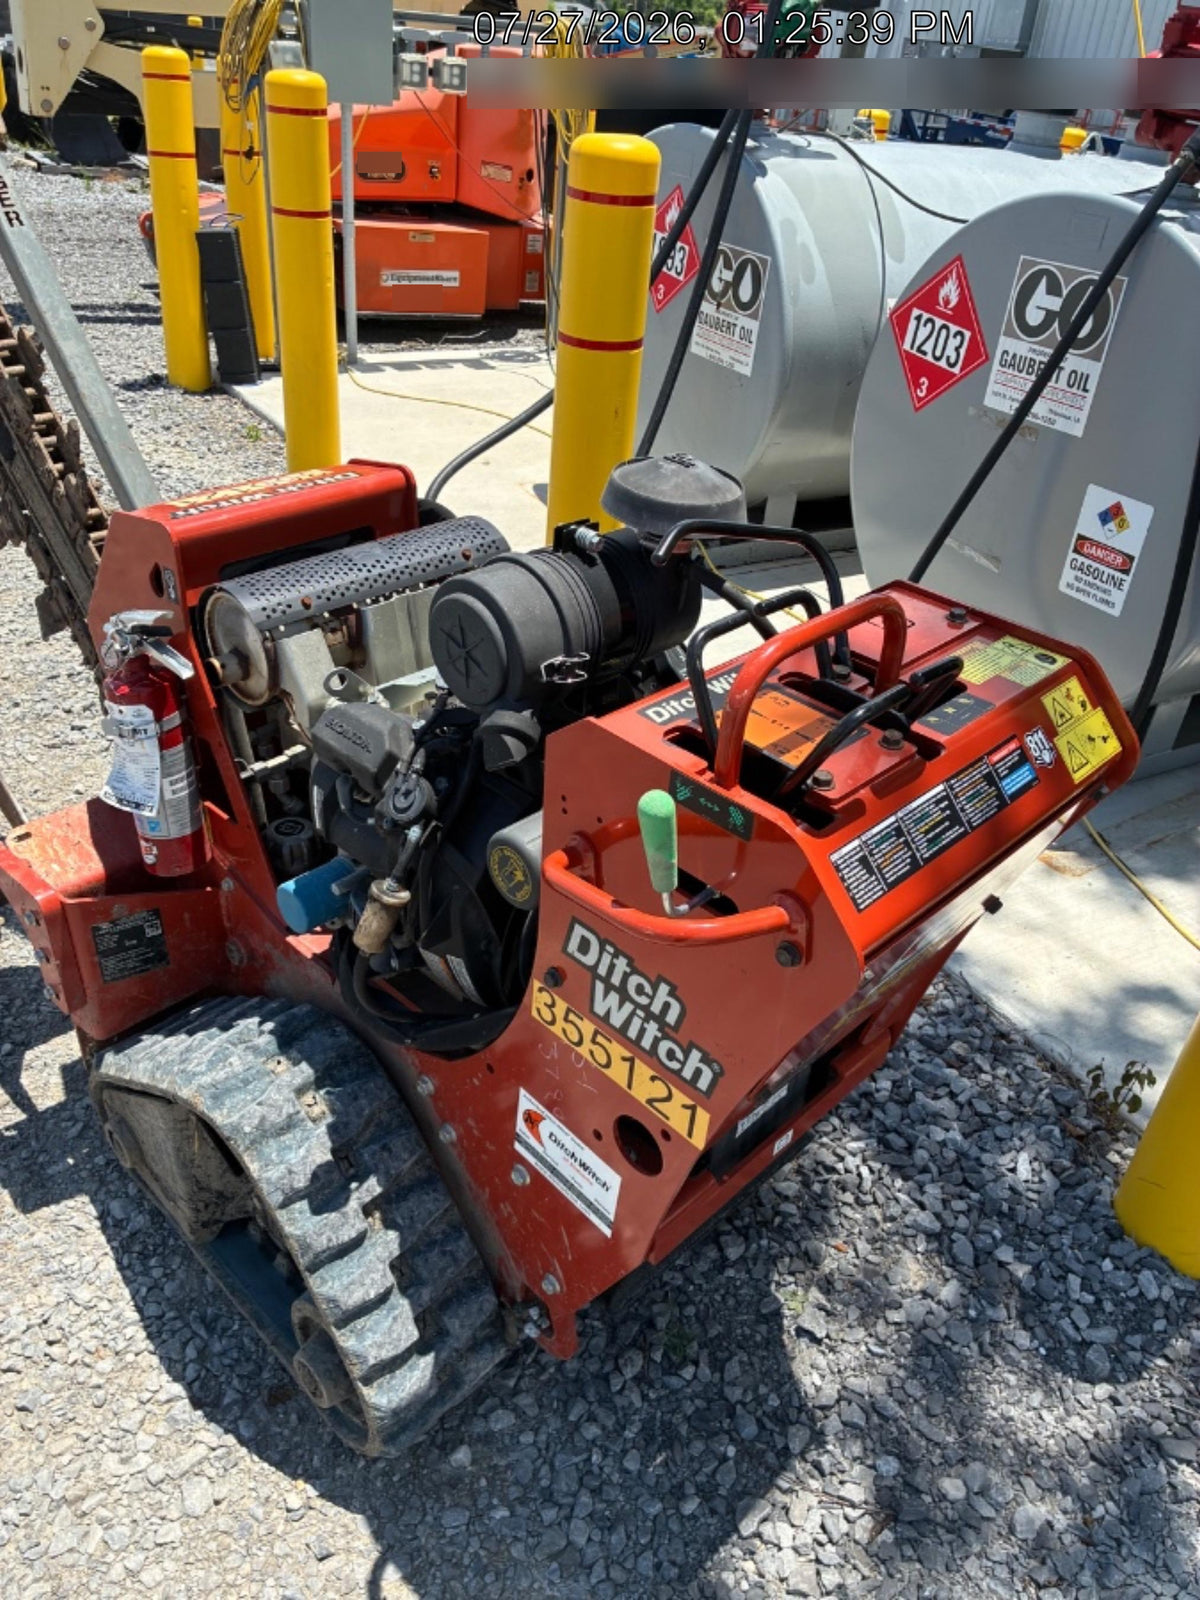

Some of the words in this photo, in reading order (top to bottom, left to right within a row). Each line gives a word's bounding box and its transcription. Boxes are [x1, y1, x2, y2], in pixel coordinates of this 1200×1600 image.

[657, 284, 666, 300] 3
[739, 324, 754, 344] OIL
[909, 312, 965, 369] 1203
[916, 376, 929, 398] 3
[999, 349, 1066, 384] GAUBET
[1066, 370, 1091, 394] OIL
[1083, 542, 1124, 566] DANGER
[1069, 557, 1127, 592] GASOLINE
[645, 689, 695, 724] Ditc
[566, 921, 683, 1028] Ditch
[591, 977, 716, 1094] Witch
[535, 985, 699, 1140] 355121
